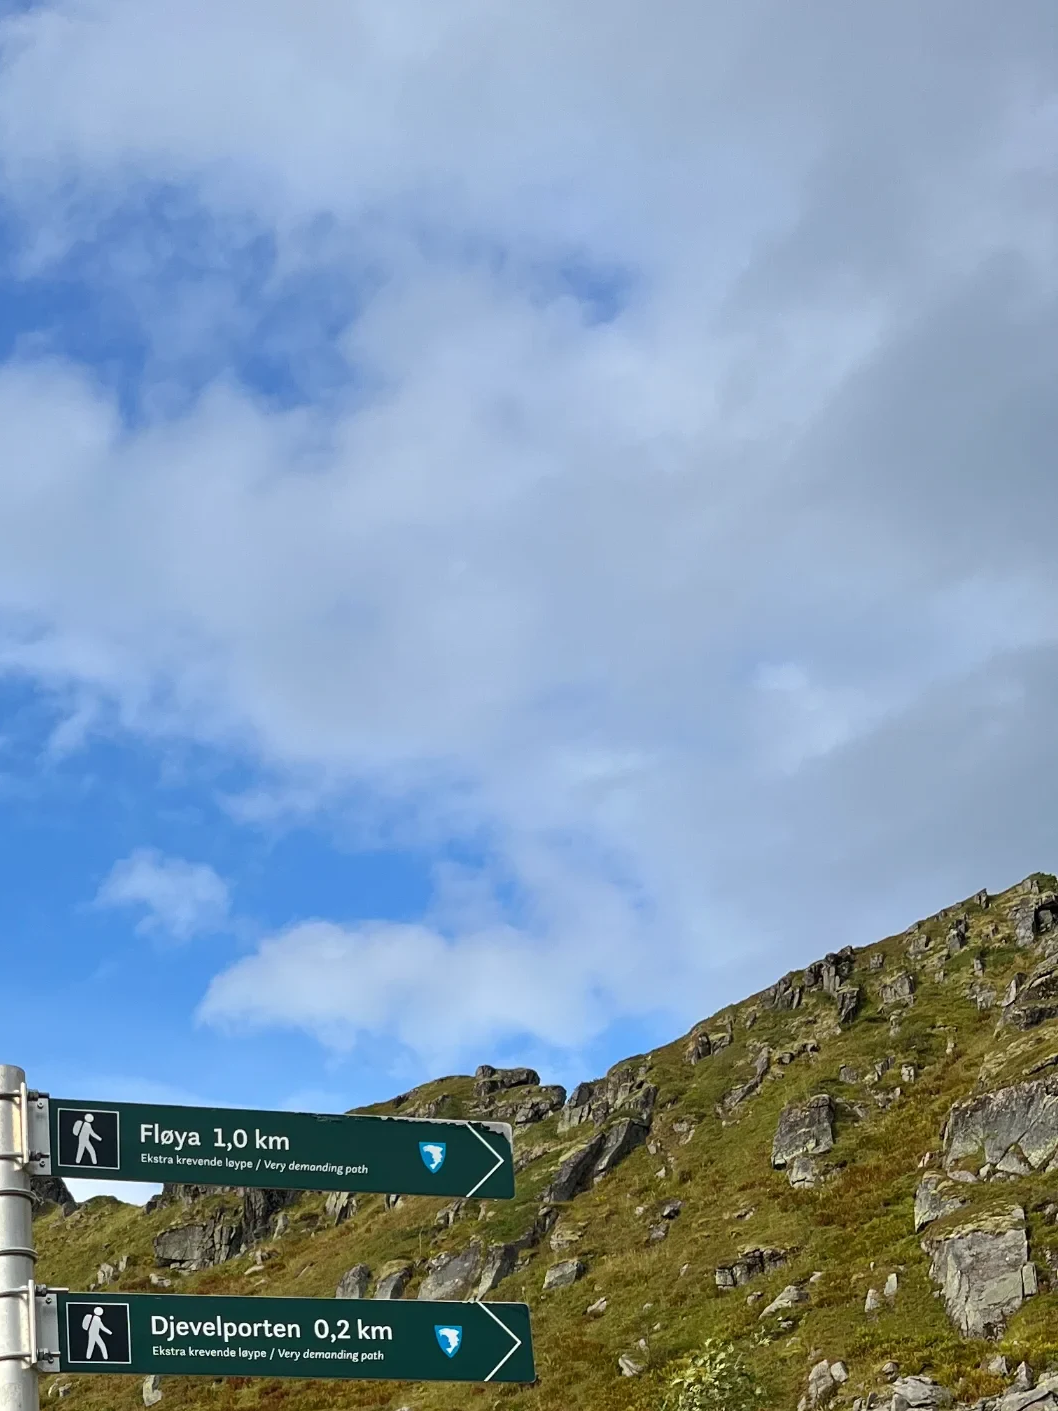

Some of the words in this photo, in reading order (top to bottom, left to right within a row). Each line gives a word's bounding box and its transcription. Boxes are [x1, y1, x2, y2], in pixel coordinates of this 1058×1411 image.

[140, 1123, 201, 1151] Fløya
[213, 1127, 248, 1151] 1,0
[255, 1128, 290, 1151] km
[140, 1153, 174, 1165] Ekstra
[176, 1155, 223, 1167] krevende
[225, 1157, 253, 1170] løype
[255, 1159, 262, 1171] /
[264, 1159, 287, 1173] Very
[288, 1161, 344, 1175] demanding
[345, 1164, 369, 1176] path
[150, 1315, 301, 1343] Djevelporten
[314, 1318, 351, 1343] 0,2
[357, 1318, 393, 1340] km
[152, 1345, 186, 1357] Ekstra
[188, 1346, 236, 1358] krevende
[238, 1347, 267, 1360] løype
[269, 1347, 276, 1360] /
[278, 1348, 301, 1361] Very
[302, 1349, 359, 1362] demanding
[360, 1350, 384, 1362] path
